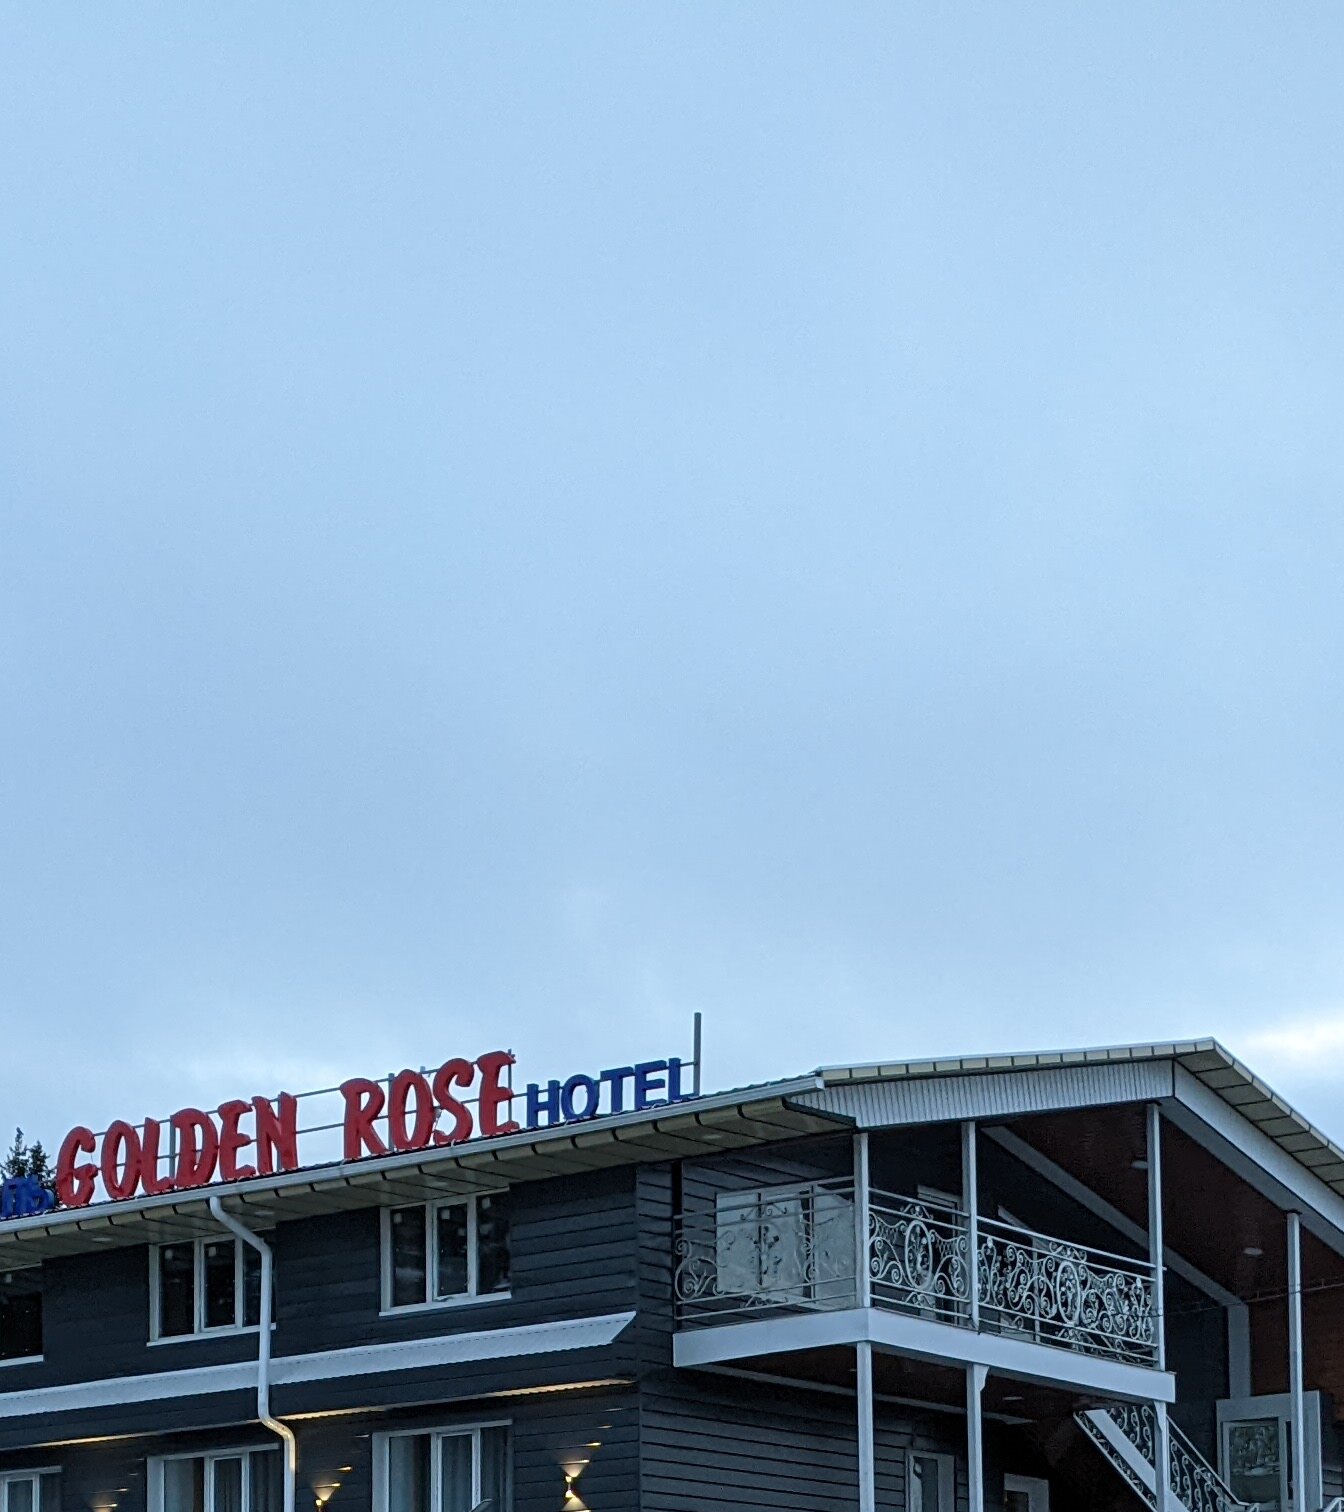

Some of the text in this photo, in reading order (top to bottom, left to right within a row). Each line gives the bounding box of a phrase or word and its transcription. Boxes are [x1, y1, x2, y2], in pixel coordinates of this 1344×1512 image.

[56, 1051, 521, 1207] GOLDEN ROSE
[527, 1057, 693, 1128] HOTEL
